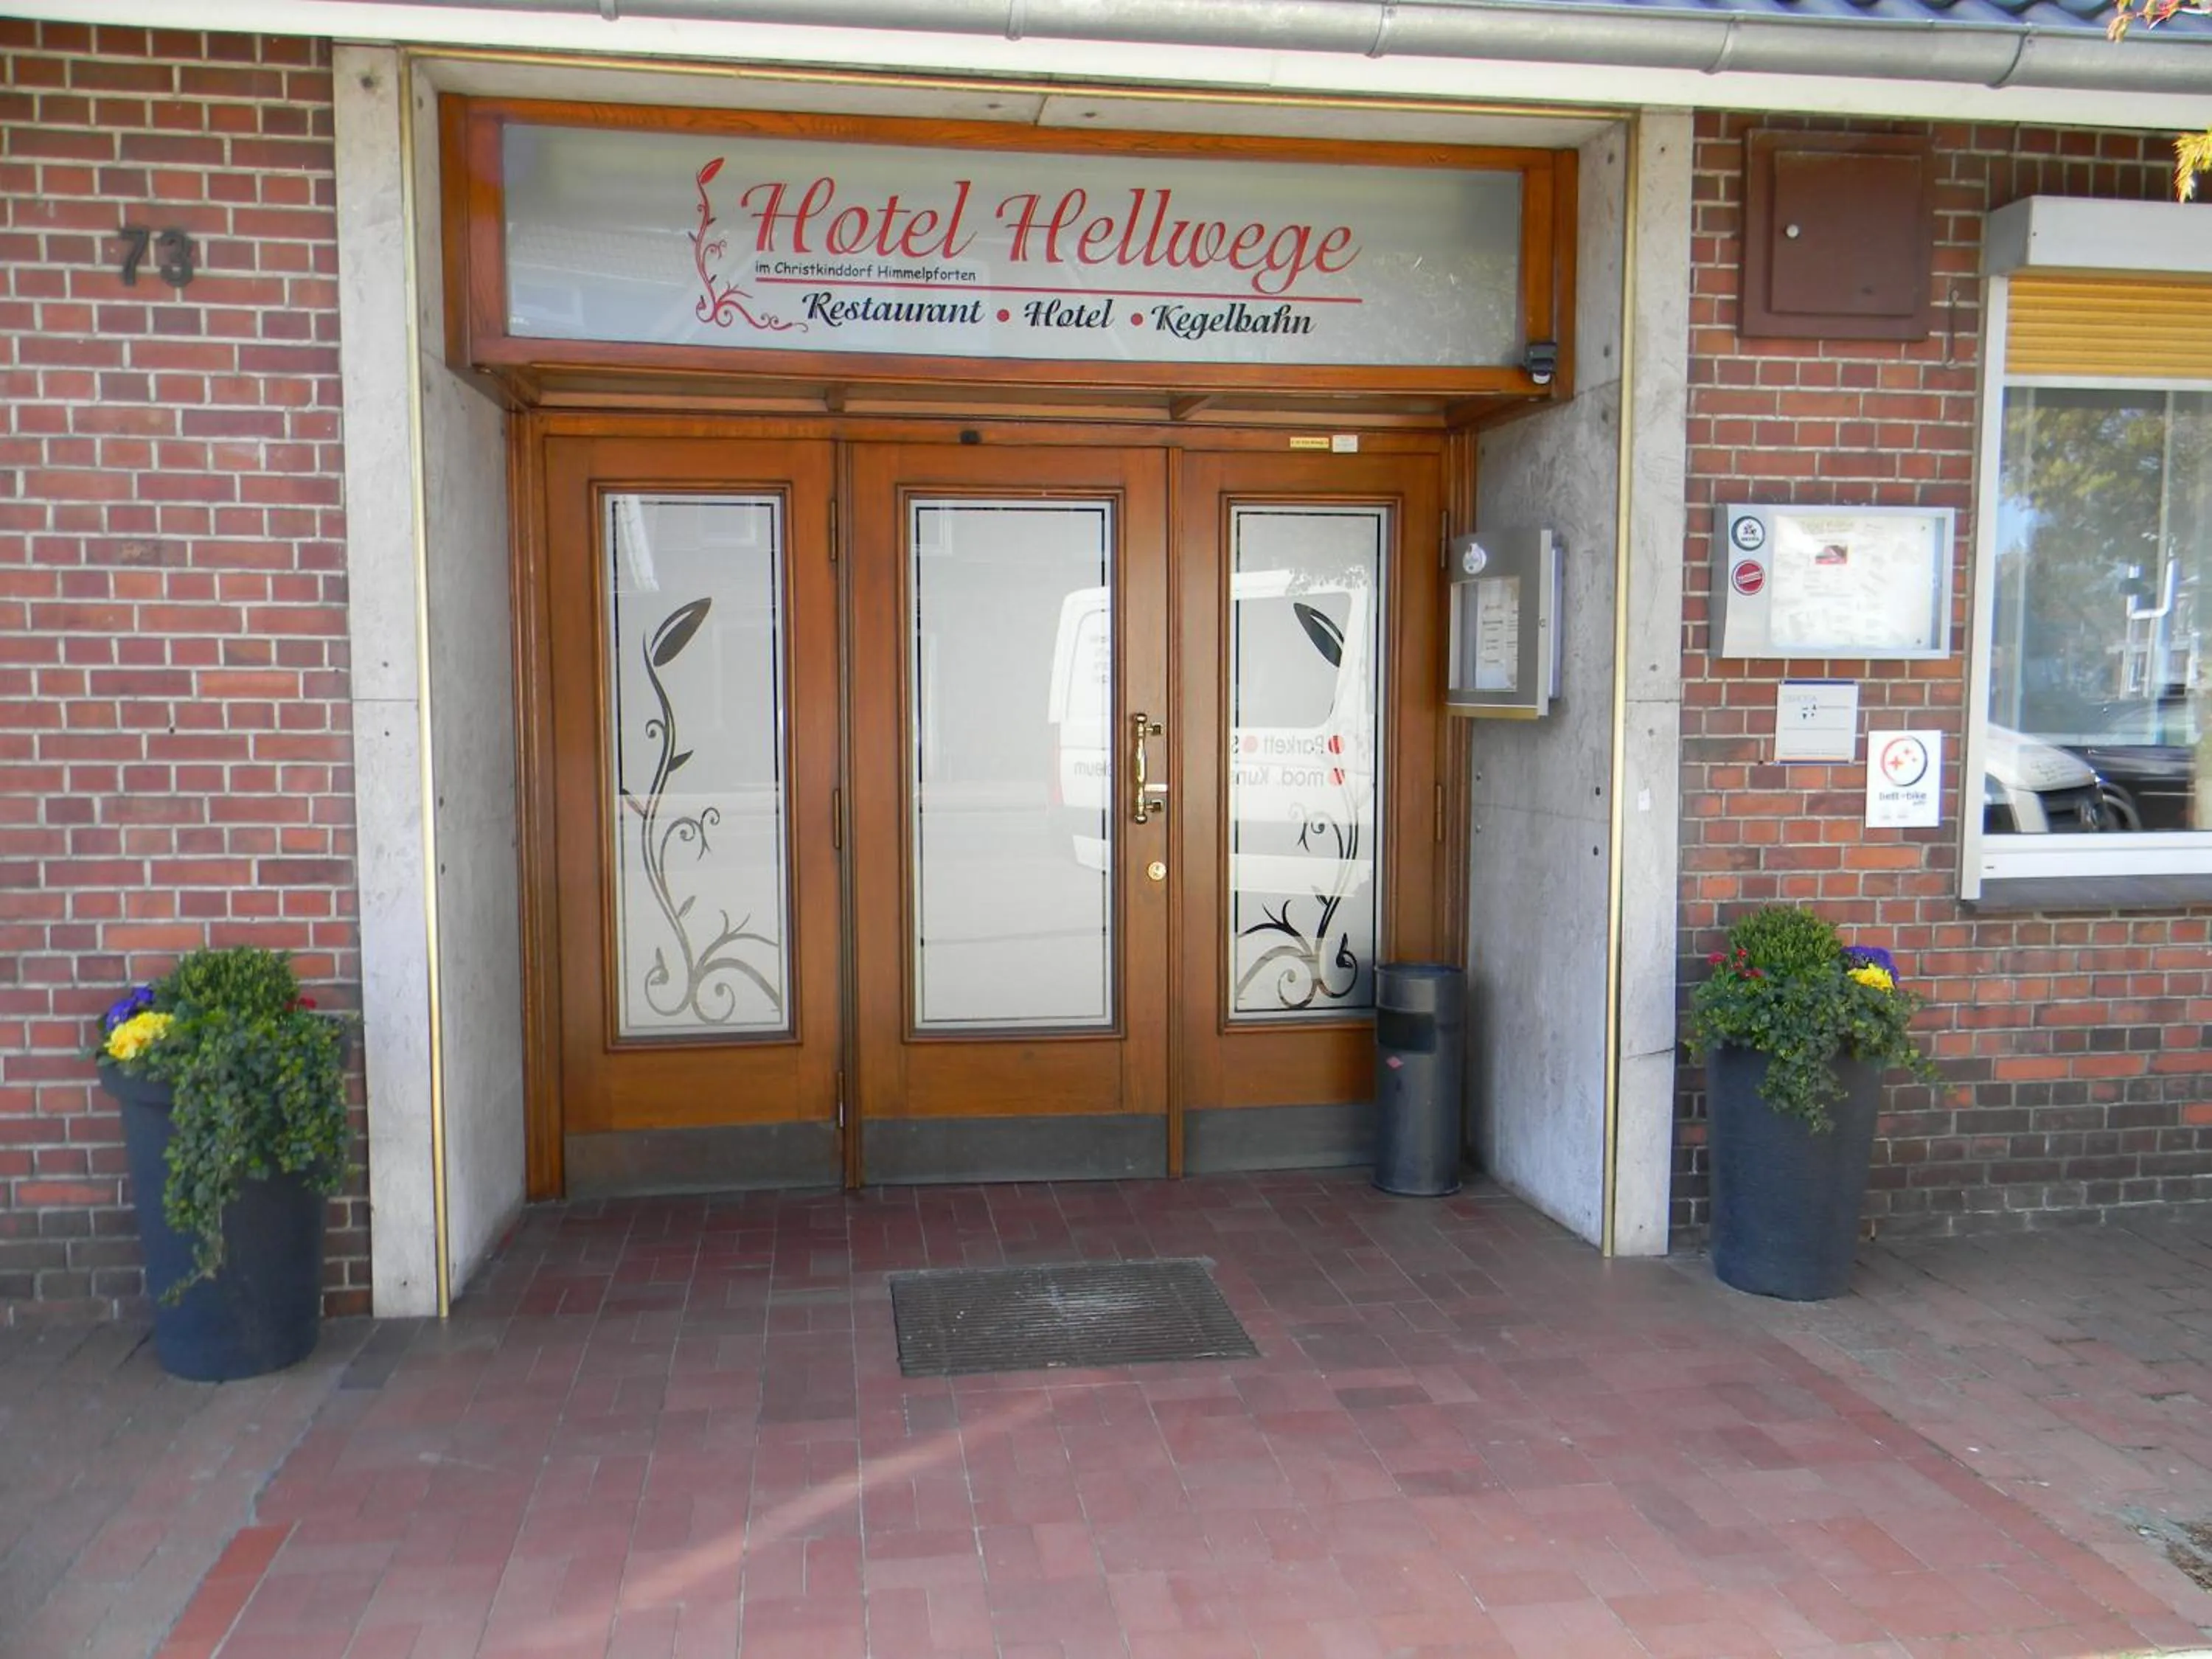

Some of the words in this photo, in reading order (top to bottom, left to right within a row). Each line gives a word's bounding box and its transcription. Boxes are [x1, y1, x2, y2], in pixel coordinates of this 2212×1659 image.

[119, 226, 193, 288] 73
[741, 177, 978, 259] Hotel
[995, 187, 1363, 294] Hellwege
[755, 262, 771, 274] im
[774, 262, 874, 279] Christkinddorf
[877, 265, 976, 282] Himmelpforten
[802, 291, 985, 327] Restaurant
[1024, 298, 1115, 329] Hotel
[1151, 302, 1315, 341] Kegelbahn
